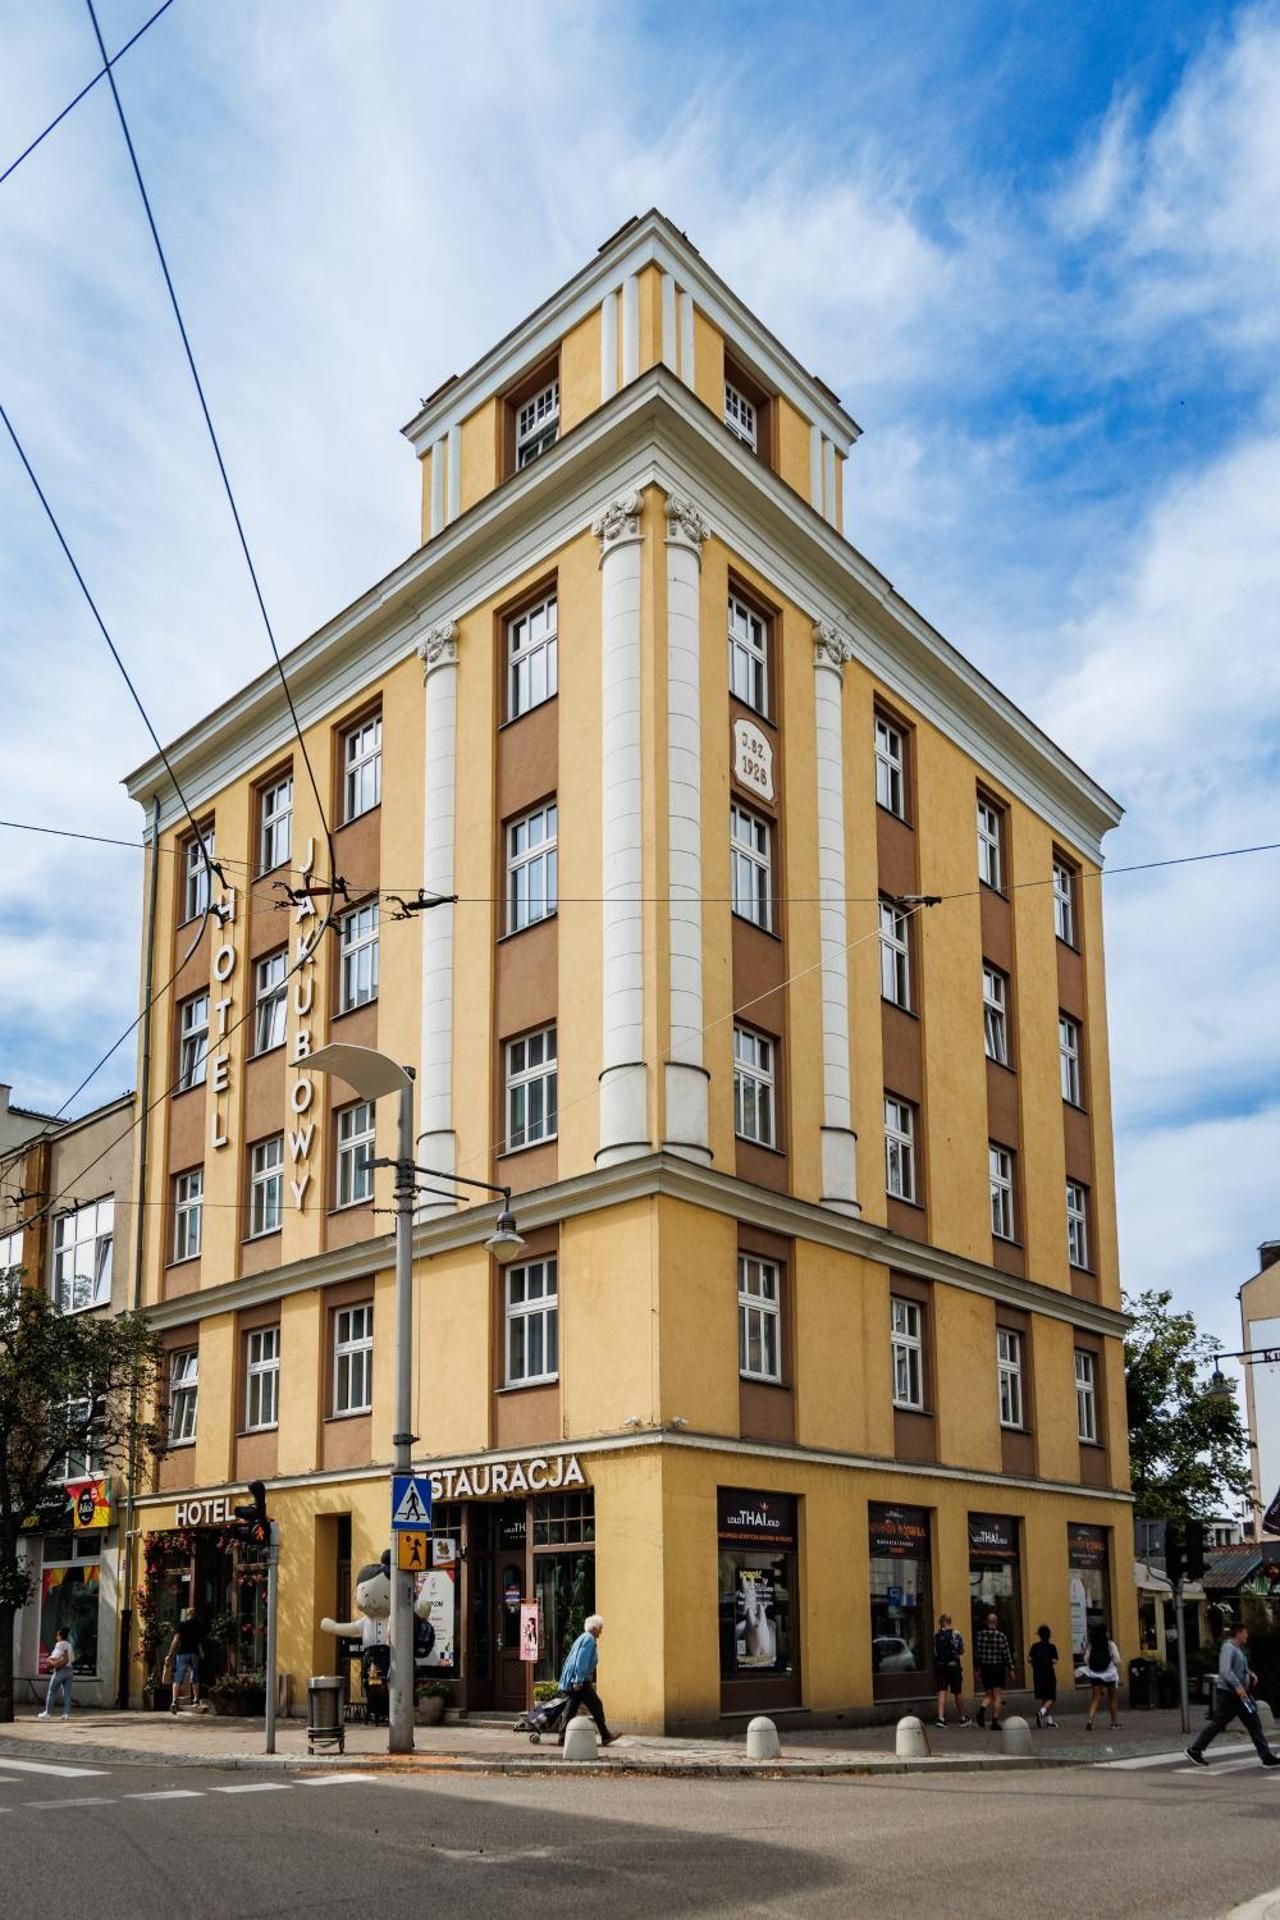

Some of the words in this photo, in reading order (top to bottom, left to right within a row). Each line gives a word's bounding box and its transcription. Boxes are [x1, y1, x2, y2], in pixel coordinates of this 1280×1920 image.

[742, 755, 767, 786] 1928
[211, 885, 236, 1149] HOTEL
[288, 837, 316, 1212] JAKUBOWY
[414, 1455, 584, 1500] STAURACJA
[175, 1497, 236, 1527] HOTEL
